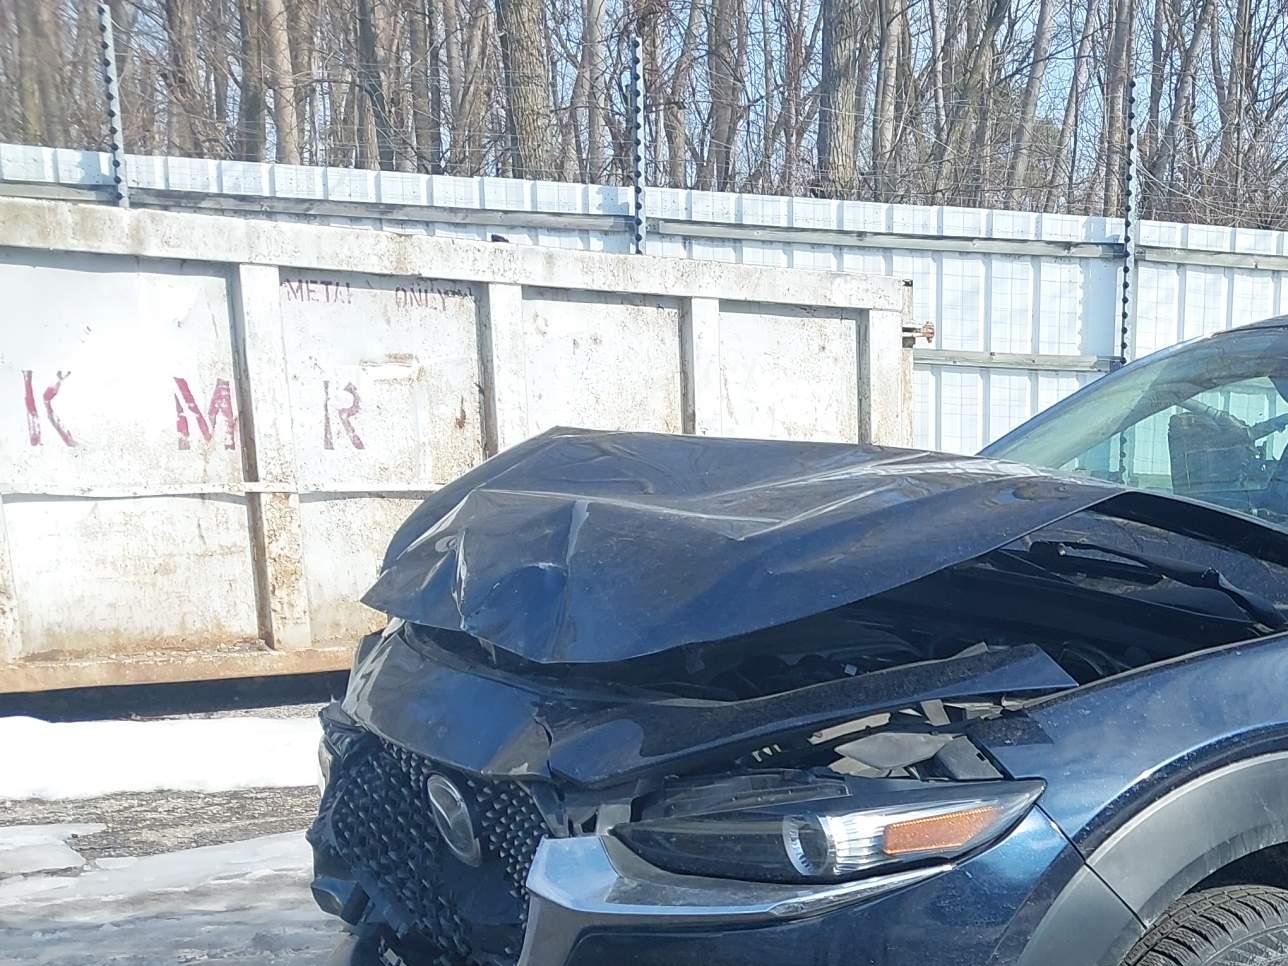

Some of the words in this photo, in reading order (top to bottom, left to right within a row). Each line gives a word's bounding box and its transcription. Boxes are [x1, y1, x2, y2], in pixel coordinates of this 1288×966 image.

[22, 369, 79, 447] K
[173, 377, 236, 450] M
[323, 379, 366, 450] R
